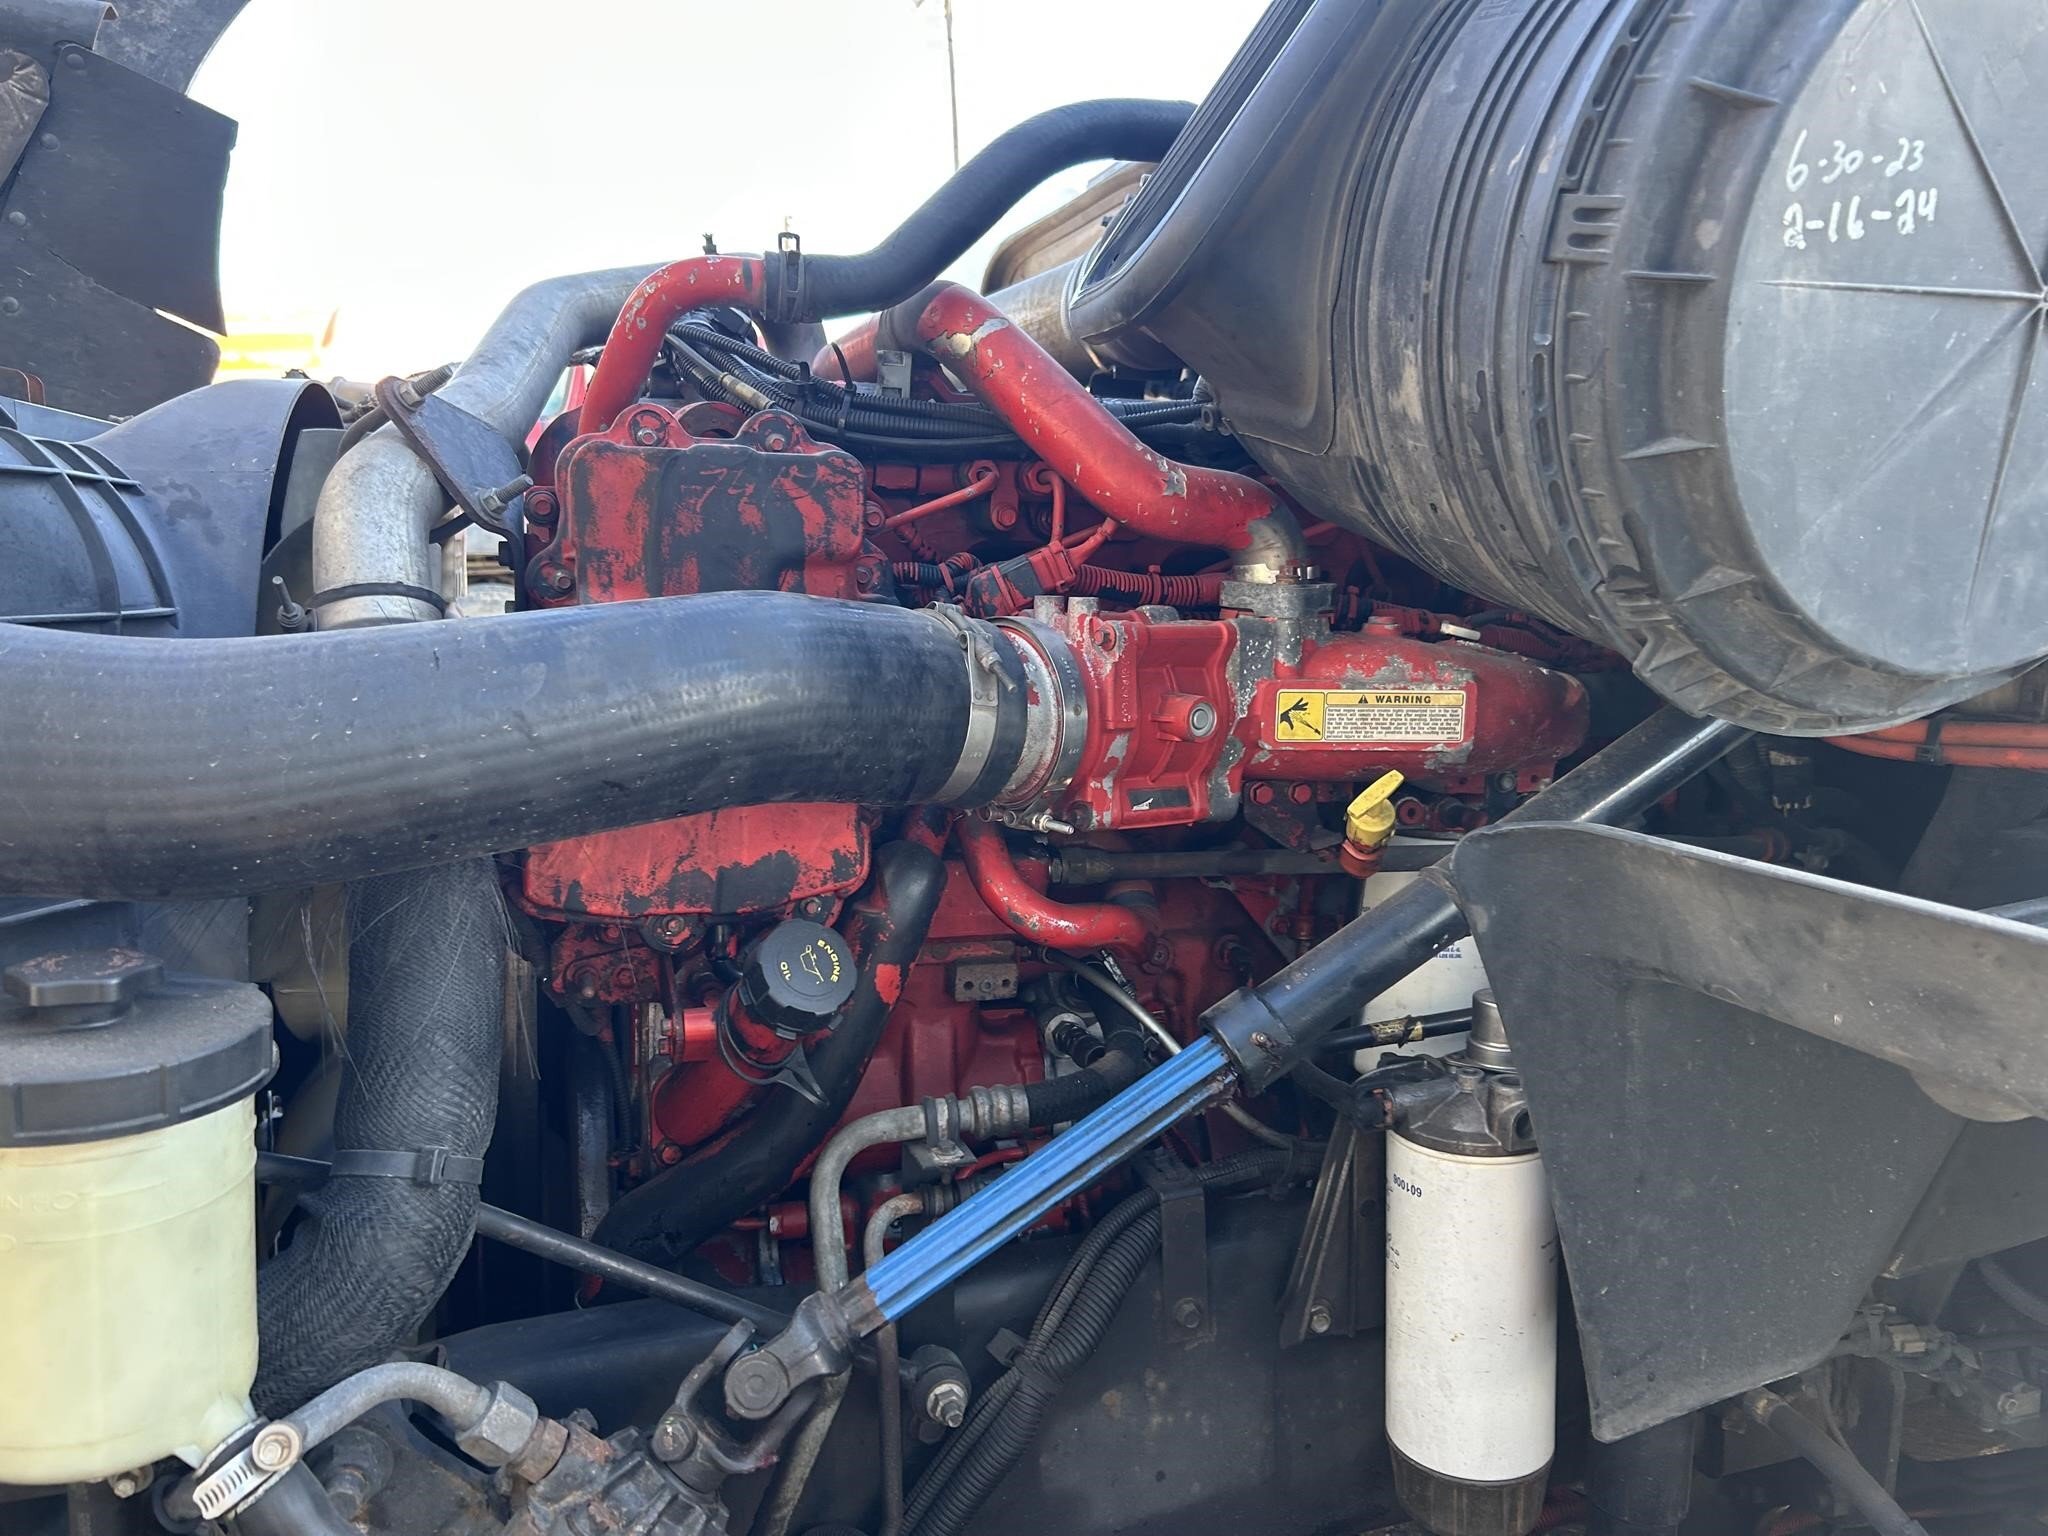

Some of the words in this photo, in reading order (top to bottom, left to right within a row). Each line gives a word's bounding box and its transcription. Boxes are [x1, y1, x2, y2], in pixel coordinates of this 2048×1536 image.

[1783, 187, 1938, 250] 2-16-24
[1375, 695, 1431, 704] WARNING
[780, 961, 793, 981] OIL
[817, 939, 841, 983] ENGINE
